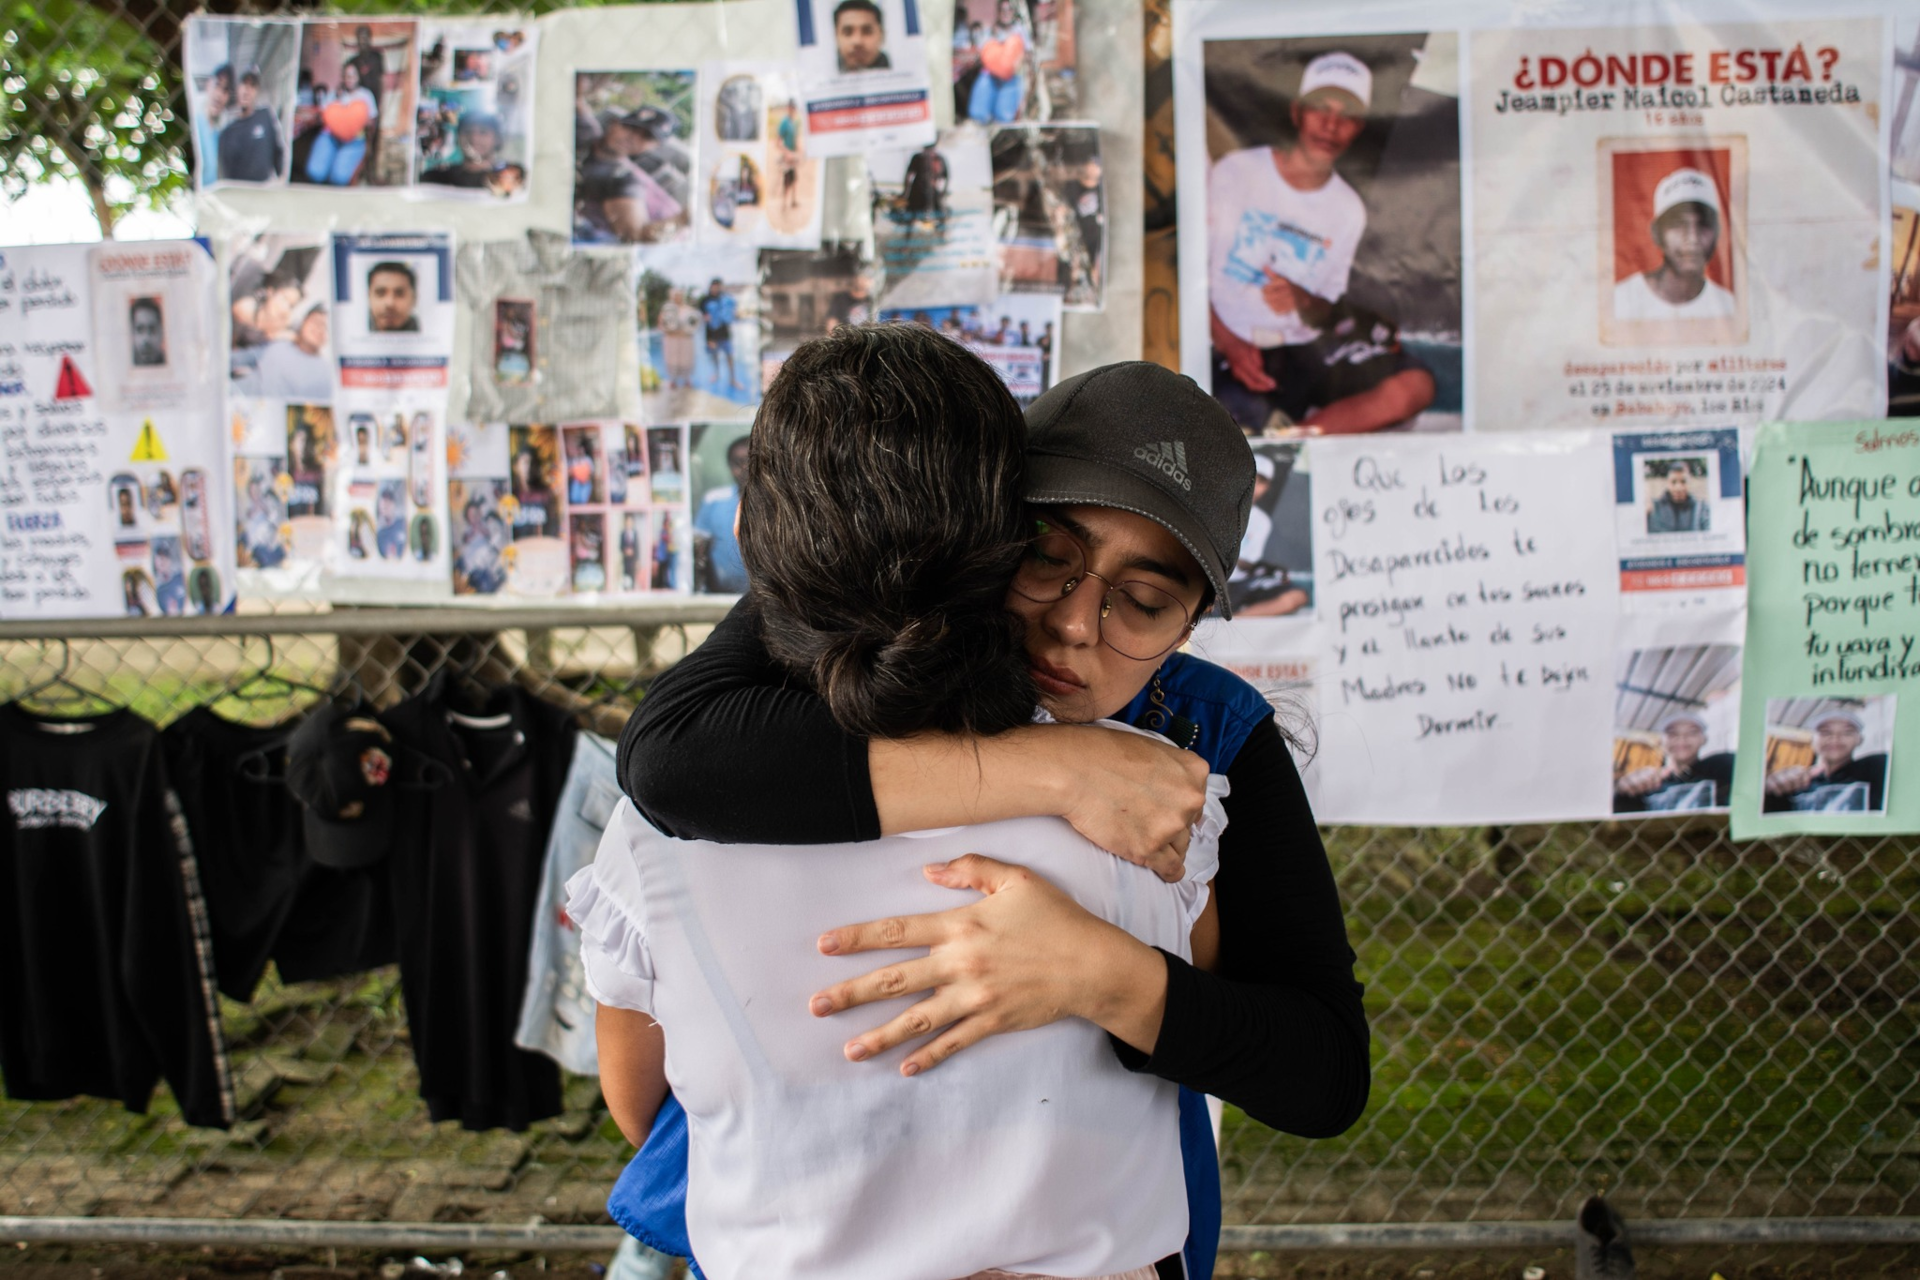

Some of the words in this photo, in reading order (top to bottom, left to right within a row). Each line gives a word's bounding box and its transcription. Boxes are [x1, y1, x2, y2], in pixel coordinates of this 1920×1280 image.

[1514, 47, 1694, 91] ¿DÓNDE
[1709, 42, 1840, 84] ESTÁ?
[1134, 447, 1192, 491] adidas
[1353, 456, 1406, 493] Que
[1323, 500, 1376, 540] ojos
[1414, 486, 1439, 518] de
[1793, 508, 1819, 550] de
[1327, 532, 1490, 586] Desaparecidos
[1804, 558, 1840, 586] no
[1803, 590, 1895, 628] porque
[1404, 623, 1469, 651] llanto
[1490, 620, 1513, 645] de
[1900, 633, 1915, 668] y
[1341, 672, 1426, 704] Madres
